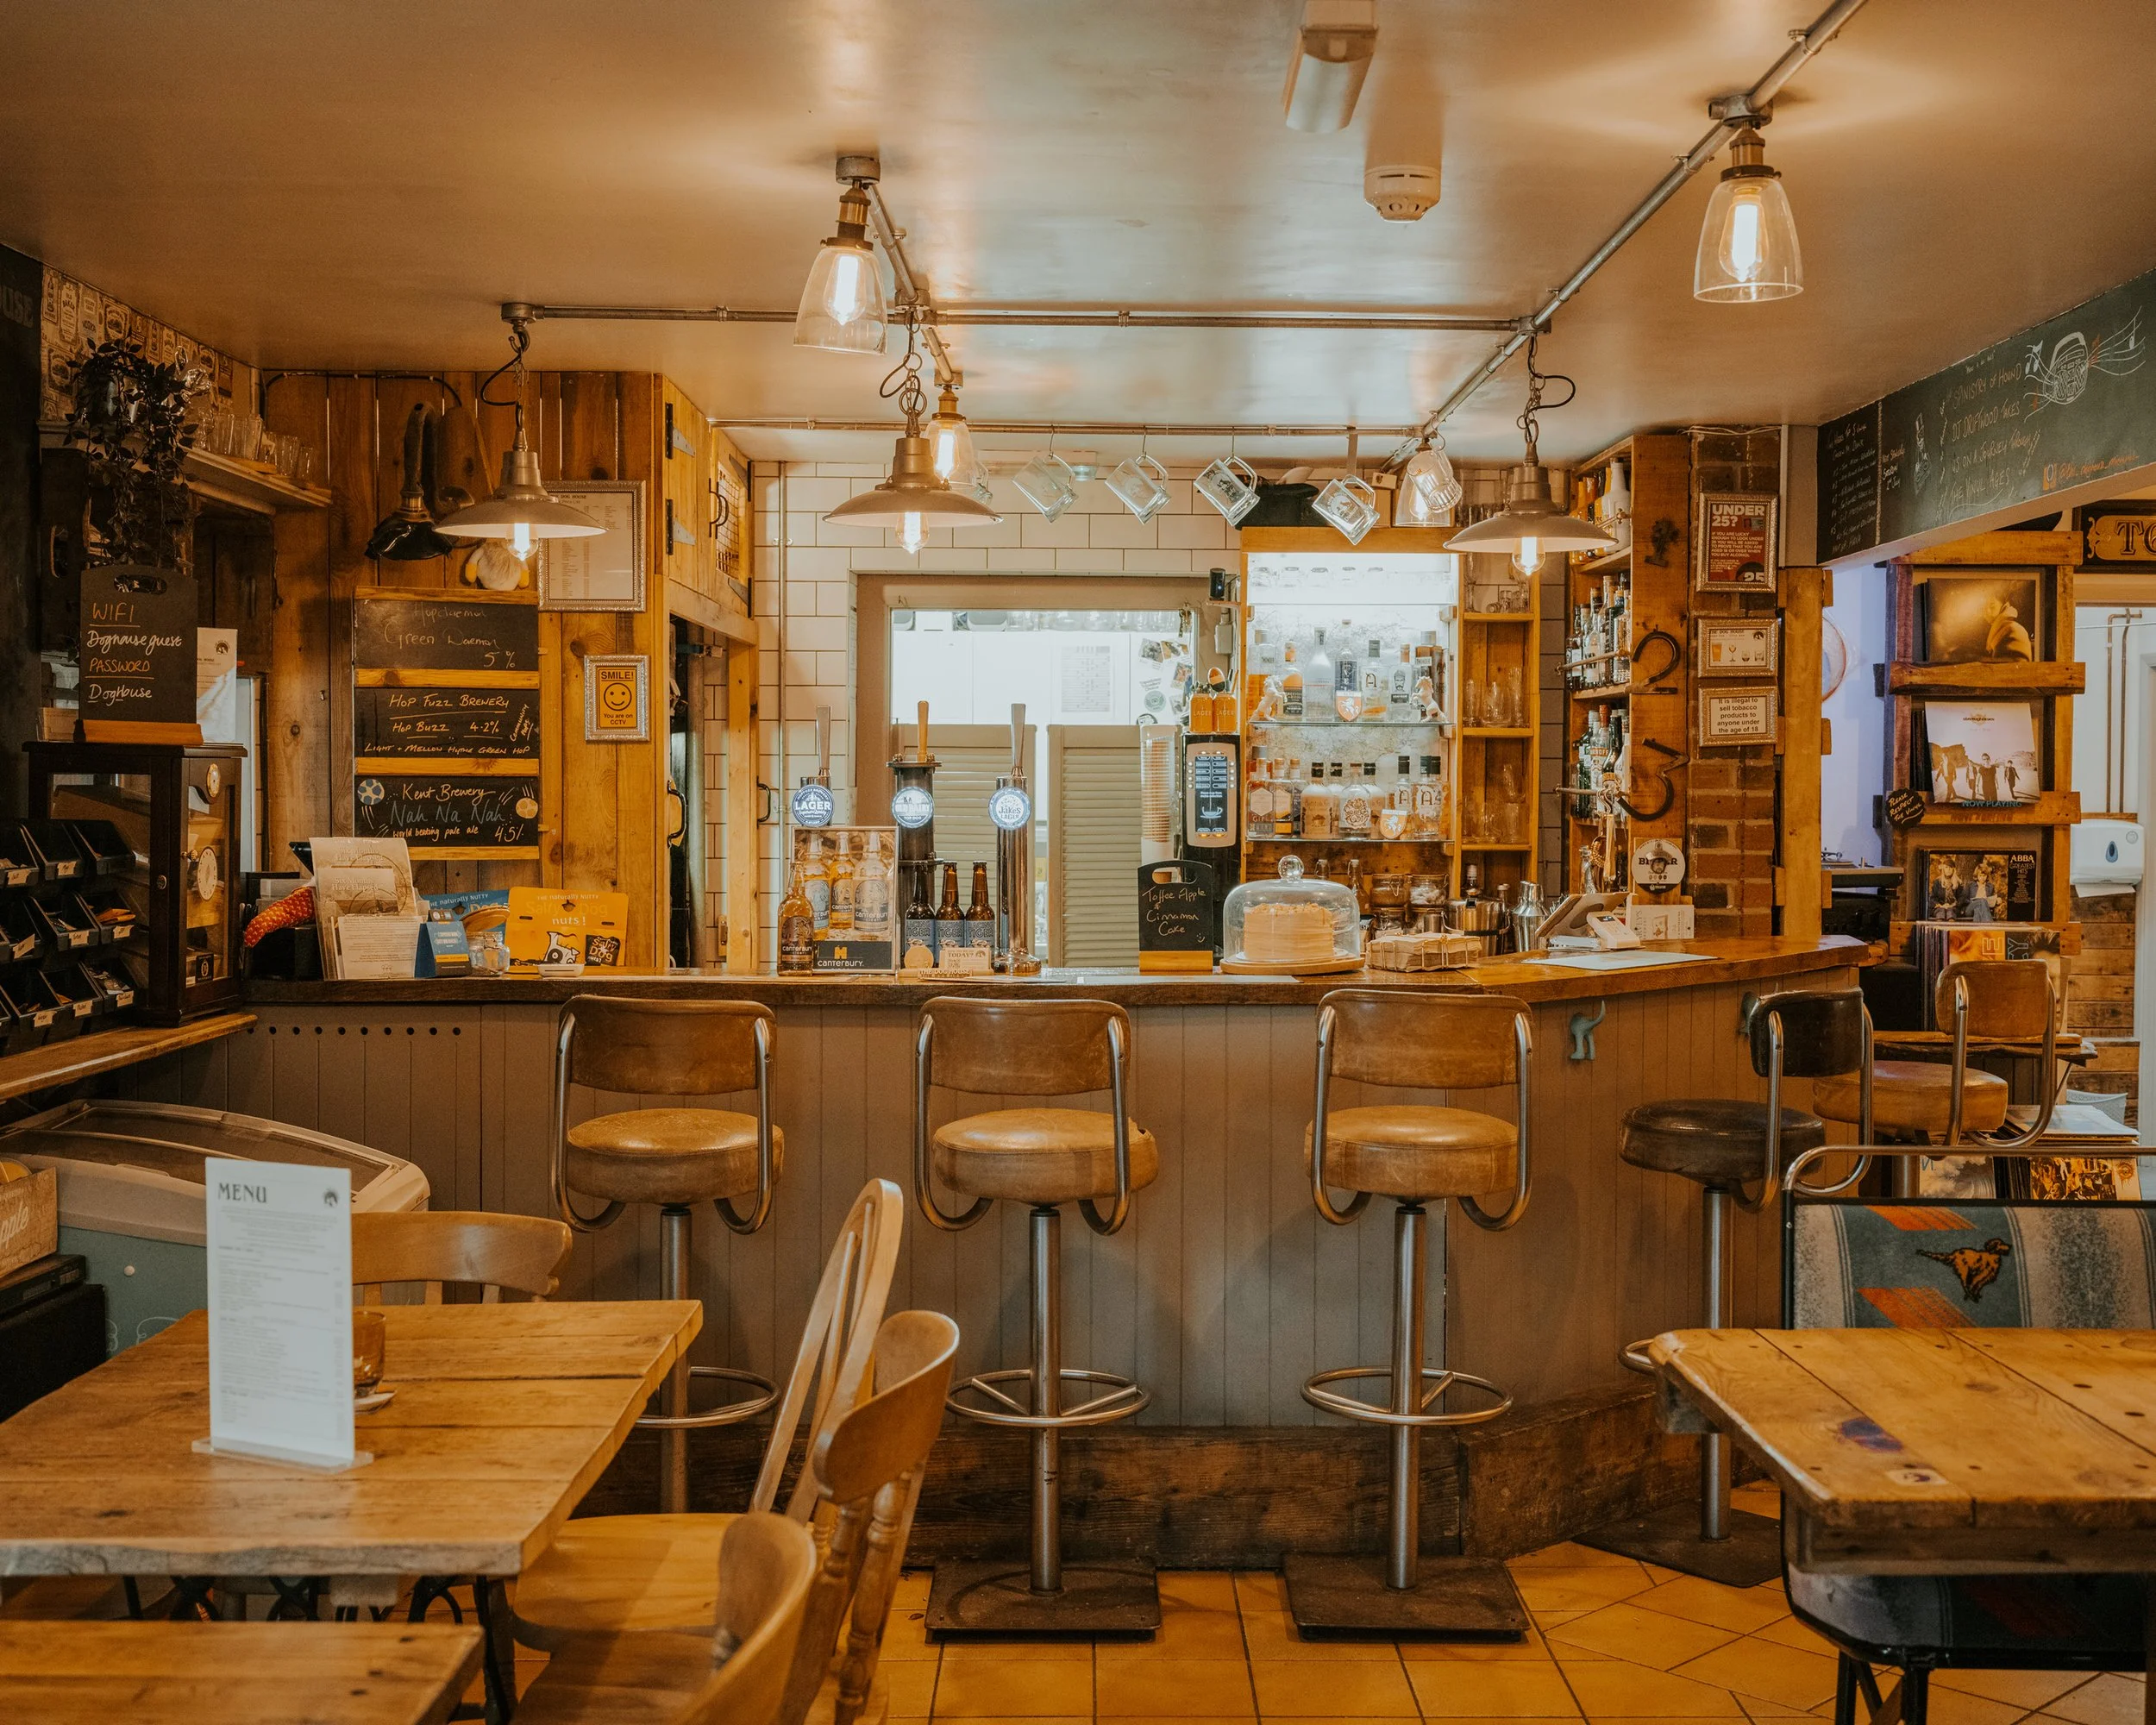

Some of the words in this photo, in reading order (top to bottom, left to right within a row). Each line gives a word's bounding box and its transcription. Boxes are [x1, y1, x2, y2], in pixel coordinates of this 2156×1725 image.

[1712, 505, 1764, 516] UNDER
[1712, 515, 1738, 527] 25?
[92, 603, 135, 622] WIFI
[385, 619, 435, 649] Green
[90, 658, 151, 673] PASSWORD
[601, 671, 634, 680] SMILE!
[402, 782, 436, 800] Kent
[436, 783, 496, 806] Brewery
[390, 800, 428, 827] Nah
[436, 801, 461, 823] Na
[470, 799, 506, 825] Nah
[795, 801, 831, 810] LAGER
[443, 825, 461, 839] pale
[467, 825, 479, 834] ale
[2009, 854, 2035, 863] ABBA
[439, 895, 469, 906] naturally
[1141, 886, 1175, 904] Toffee
[1178, 887, 1206, 902] Apple
[579, 902, 609, 917] Dog
[1146, 910, 1200, 923] Cinnamon
[1158, 920, 1186, 936] Cake
[589, 945, 614, 963] Dog
[217, 1182, 266, 1203] MENU
